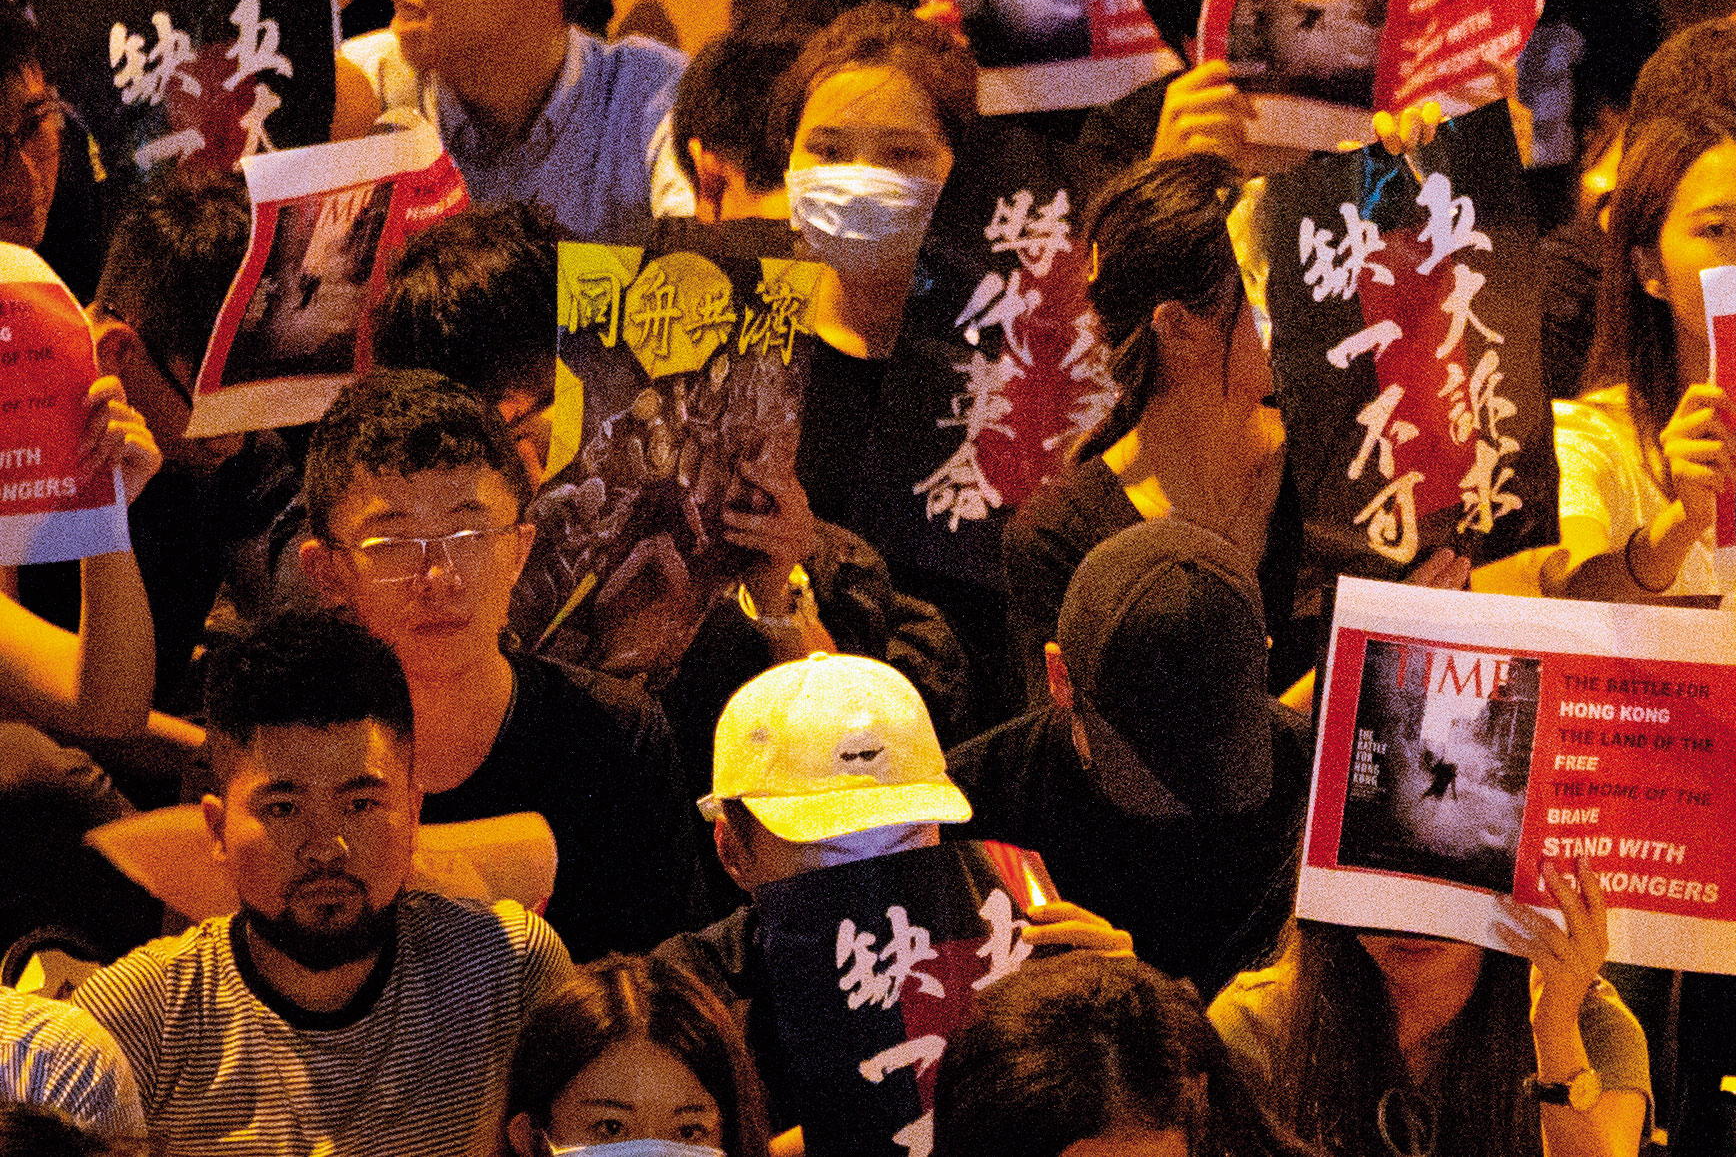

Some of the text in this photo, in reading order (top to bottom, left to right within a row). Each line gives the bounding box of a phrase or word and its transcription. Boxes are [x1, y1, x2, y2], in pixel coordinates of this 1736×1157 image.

[1415, 172, 1522, 533] 五大訴求
[1299, 202, 1424, 564] 缺一不可
[1389, 645, 1520, 705] TIME
[1564, 675, 1709, 698] THE BATTLE FOR
[1560, 701, 1671, 724] HONG KONG
[1559, 728, 1714, 753] THE LAND OF THE
[1554, 755, 1600, 771] FREE
[1554, 781, 1711, 807] THE HOME OF THE
[1547, 807, 1600, 825] BRAVE
[1542, 836, 1687, 864] STAND WITH
[1538, 869, 1720, 904] KONGERS
